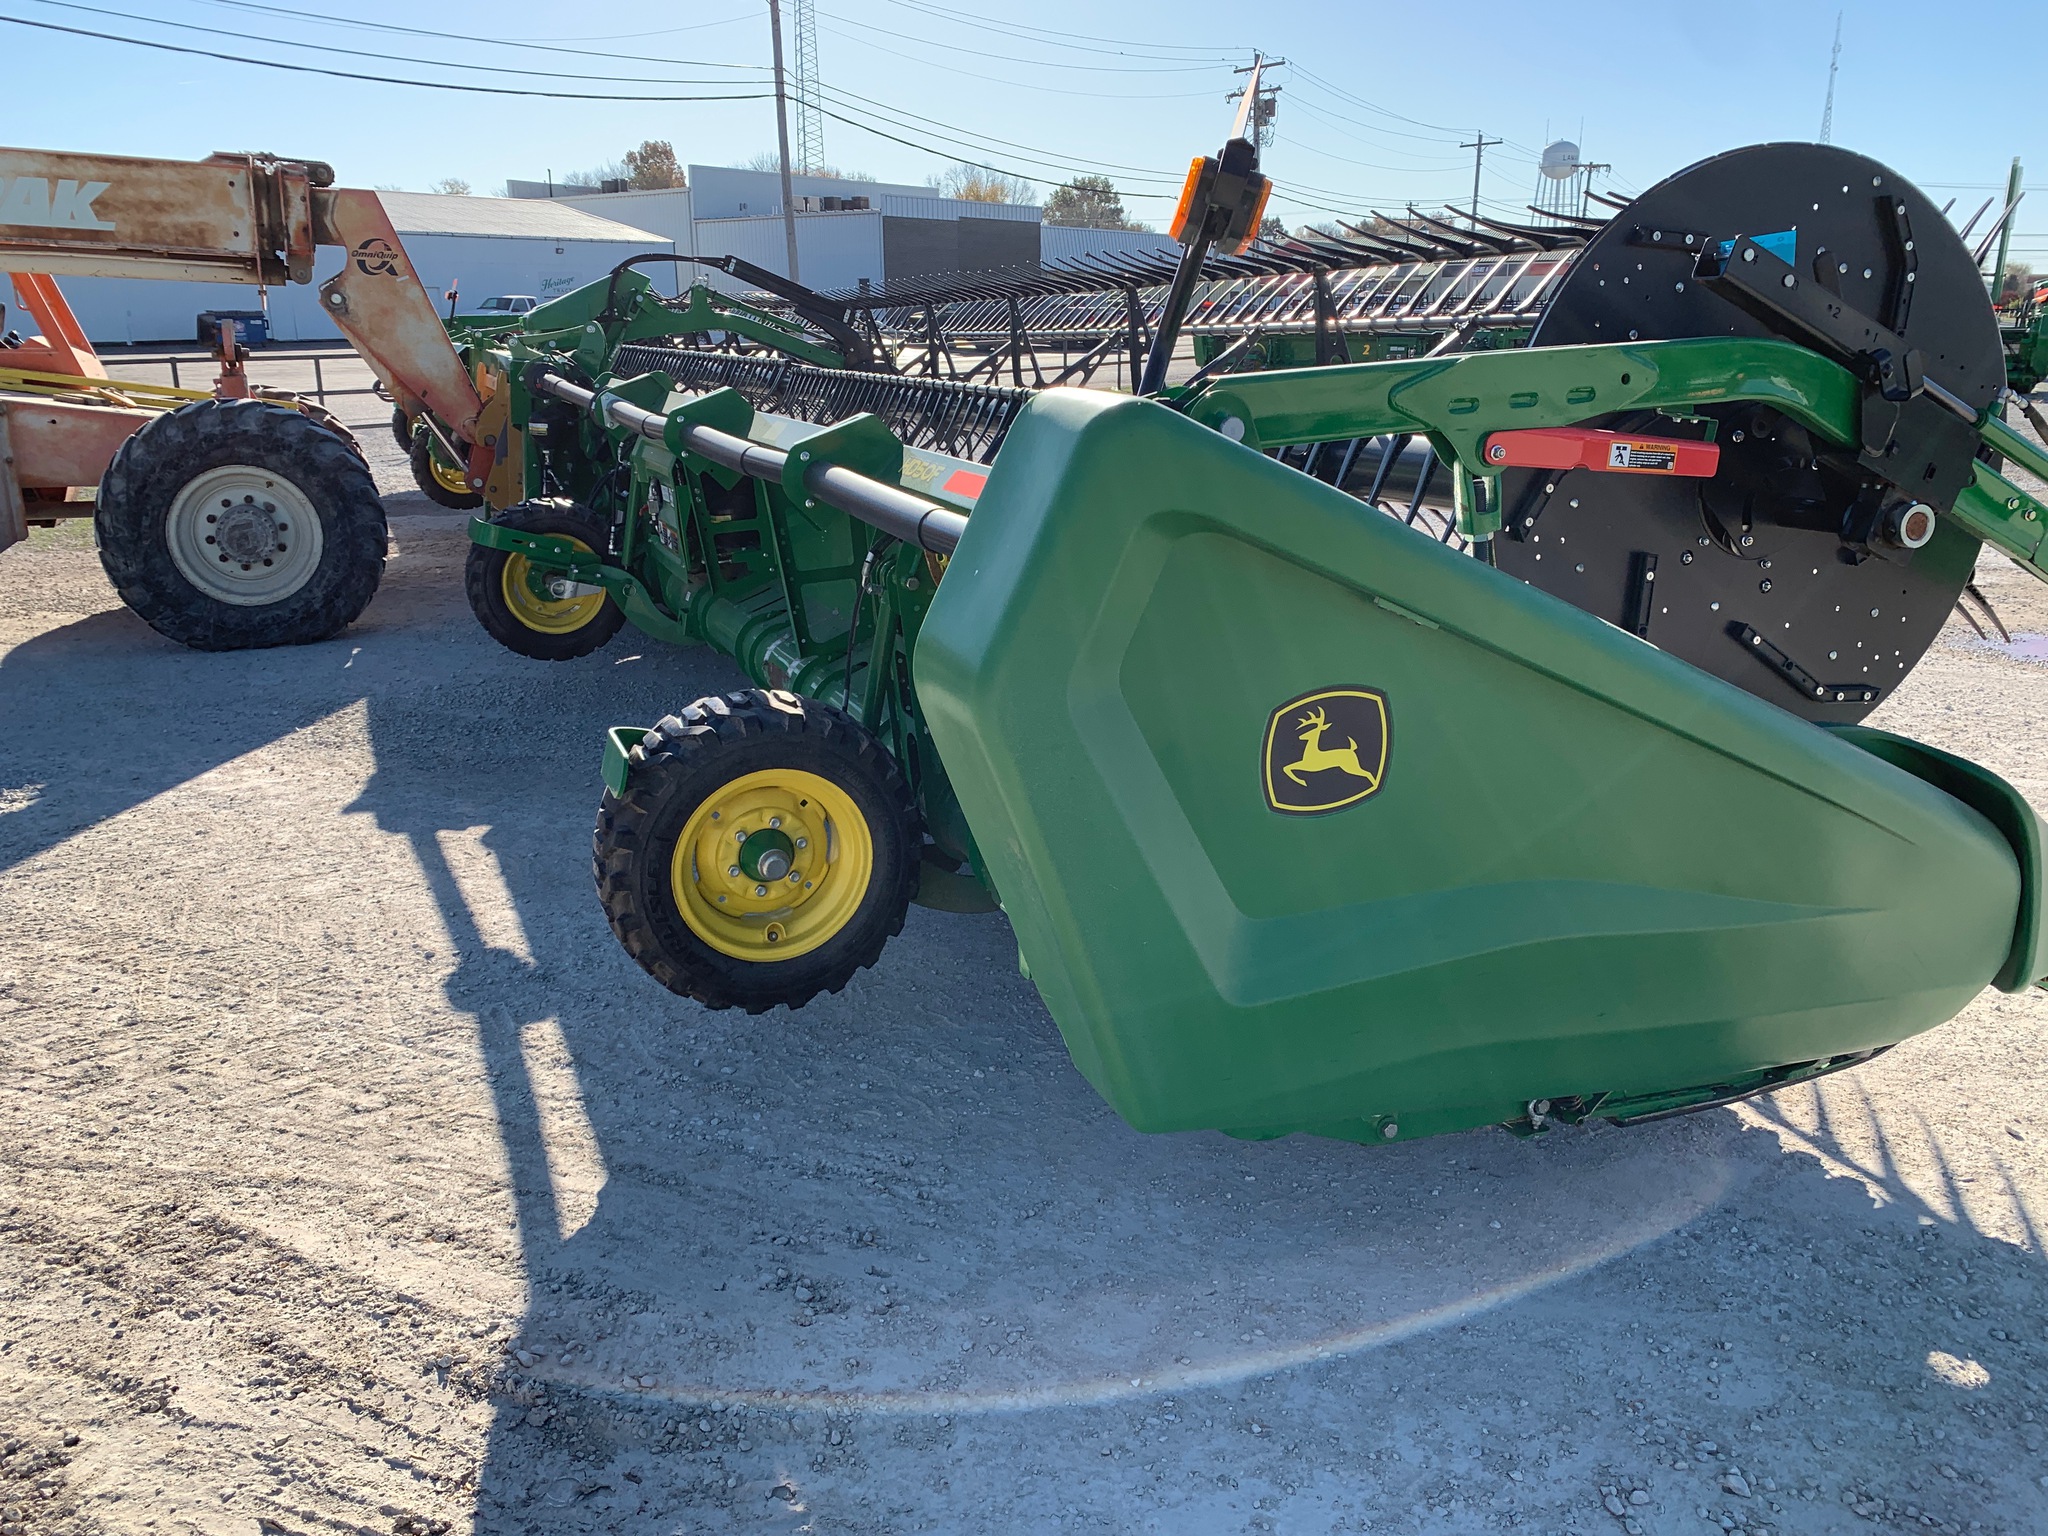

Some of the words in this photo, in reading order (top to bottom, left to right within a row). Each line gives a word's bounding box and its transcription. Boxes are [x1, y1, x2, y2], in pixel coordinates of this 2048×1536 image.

[351, 250, 398, 260] OmniQuip
[541, 276, 575, 292] Heritage
[1832, 307, 1841, 319] 2
[1362, 344, 1371, 356] 2
